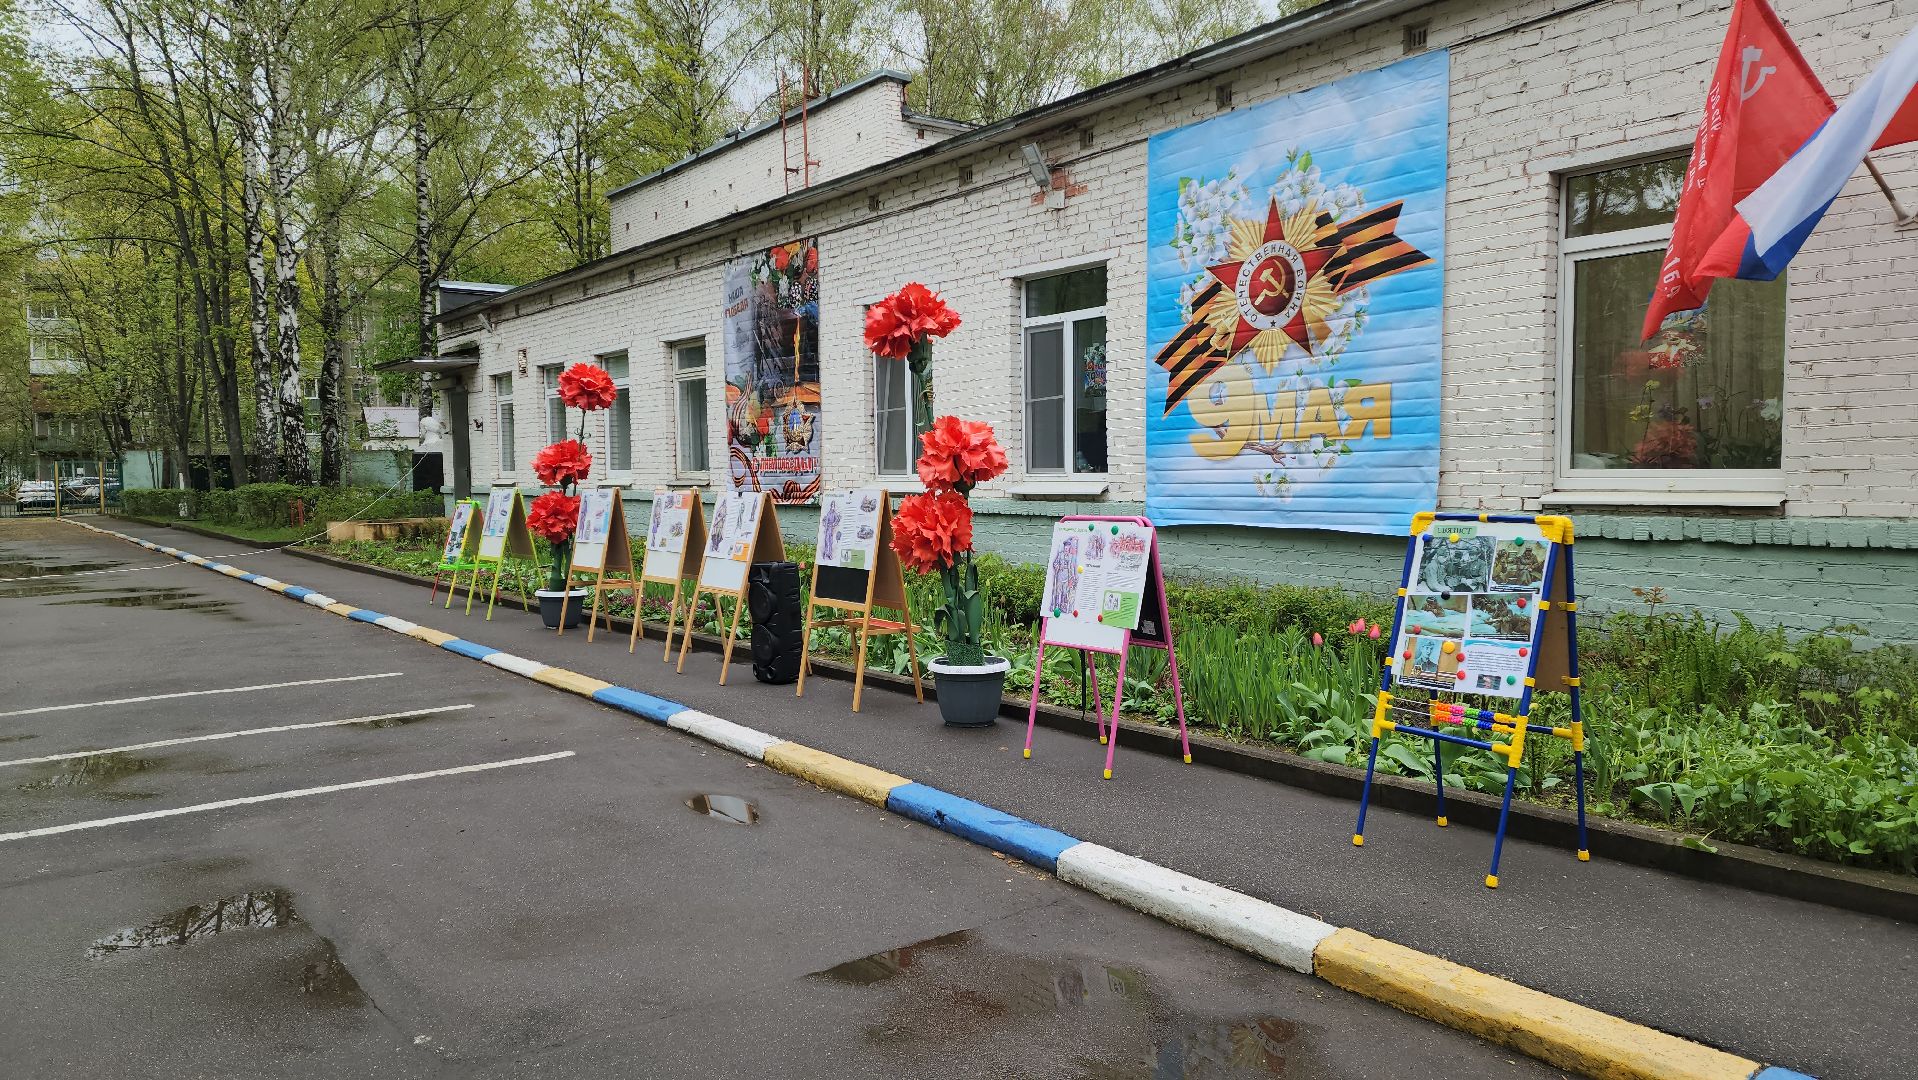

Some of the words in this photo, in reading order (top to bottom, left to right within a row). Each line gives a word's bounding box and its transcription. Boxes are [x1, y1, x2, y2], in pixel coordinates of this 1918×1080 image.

[1238, 243, 1299, 322] ОТЕЧЕСТВЕННАЯ
[1285, 268, 1304, 319] ВОЙНА
[1188, 363, 1253, 461] 9
[1248, 382, 1392, 442] МАЯ
